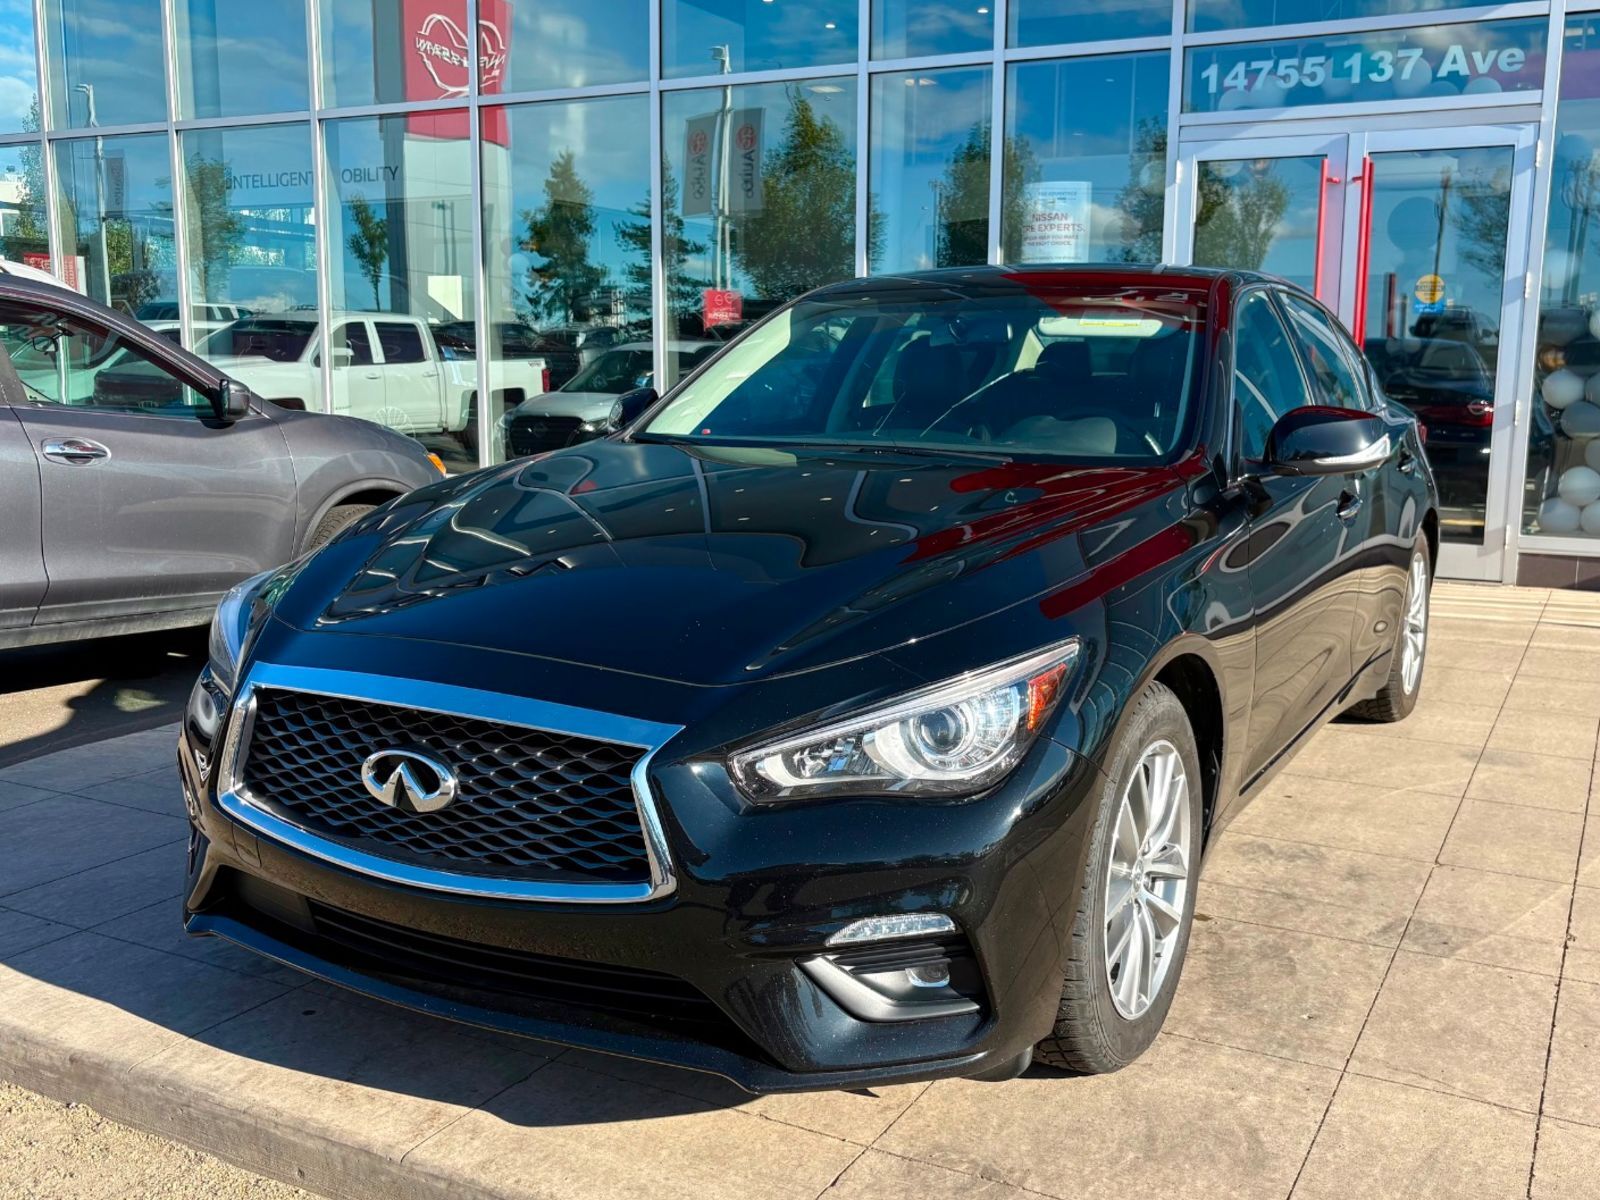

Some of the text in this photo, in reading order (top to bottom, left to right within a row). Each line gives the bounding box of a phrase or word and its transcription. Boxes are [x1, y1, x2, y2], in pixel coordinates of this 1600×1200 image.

[1200, 45, 1526, 94] 14755 137 Ave
[341, 166, 399, 184] OBILITY
[1032, 213, 1069, 222] NISSAN
